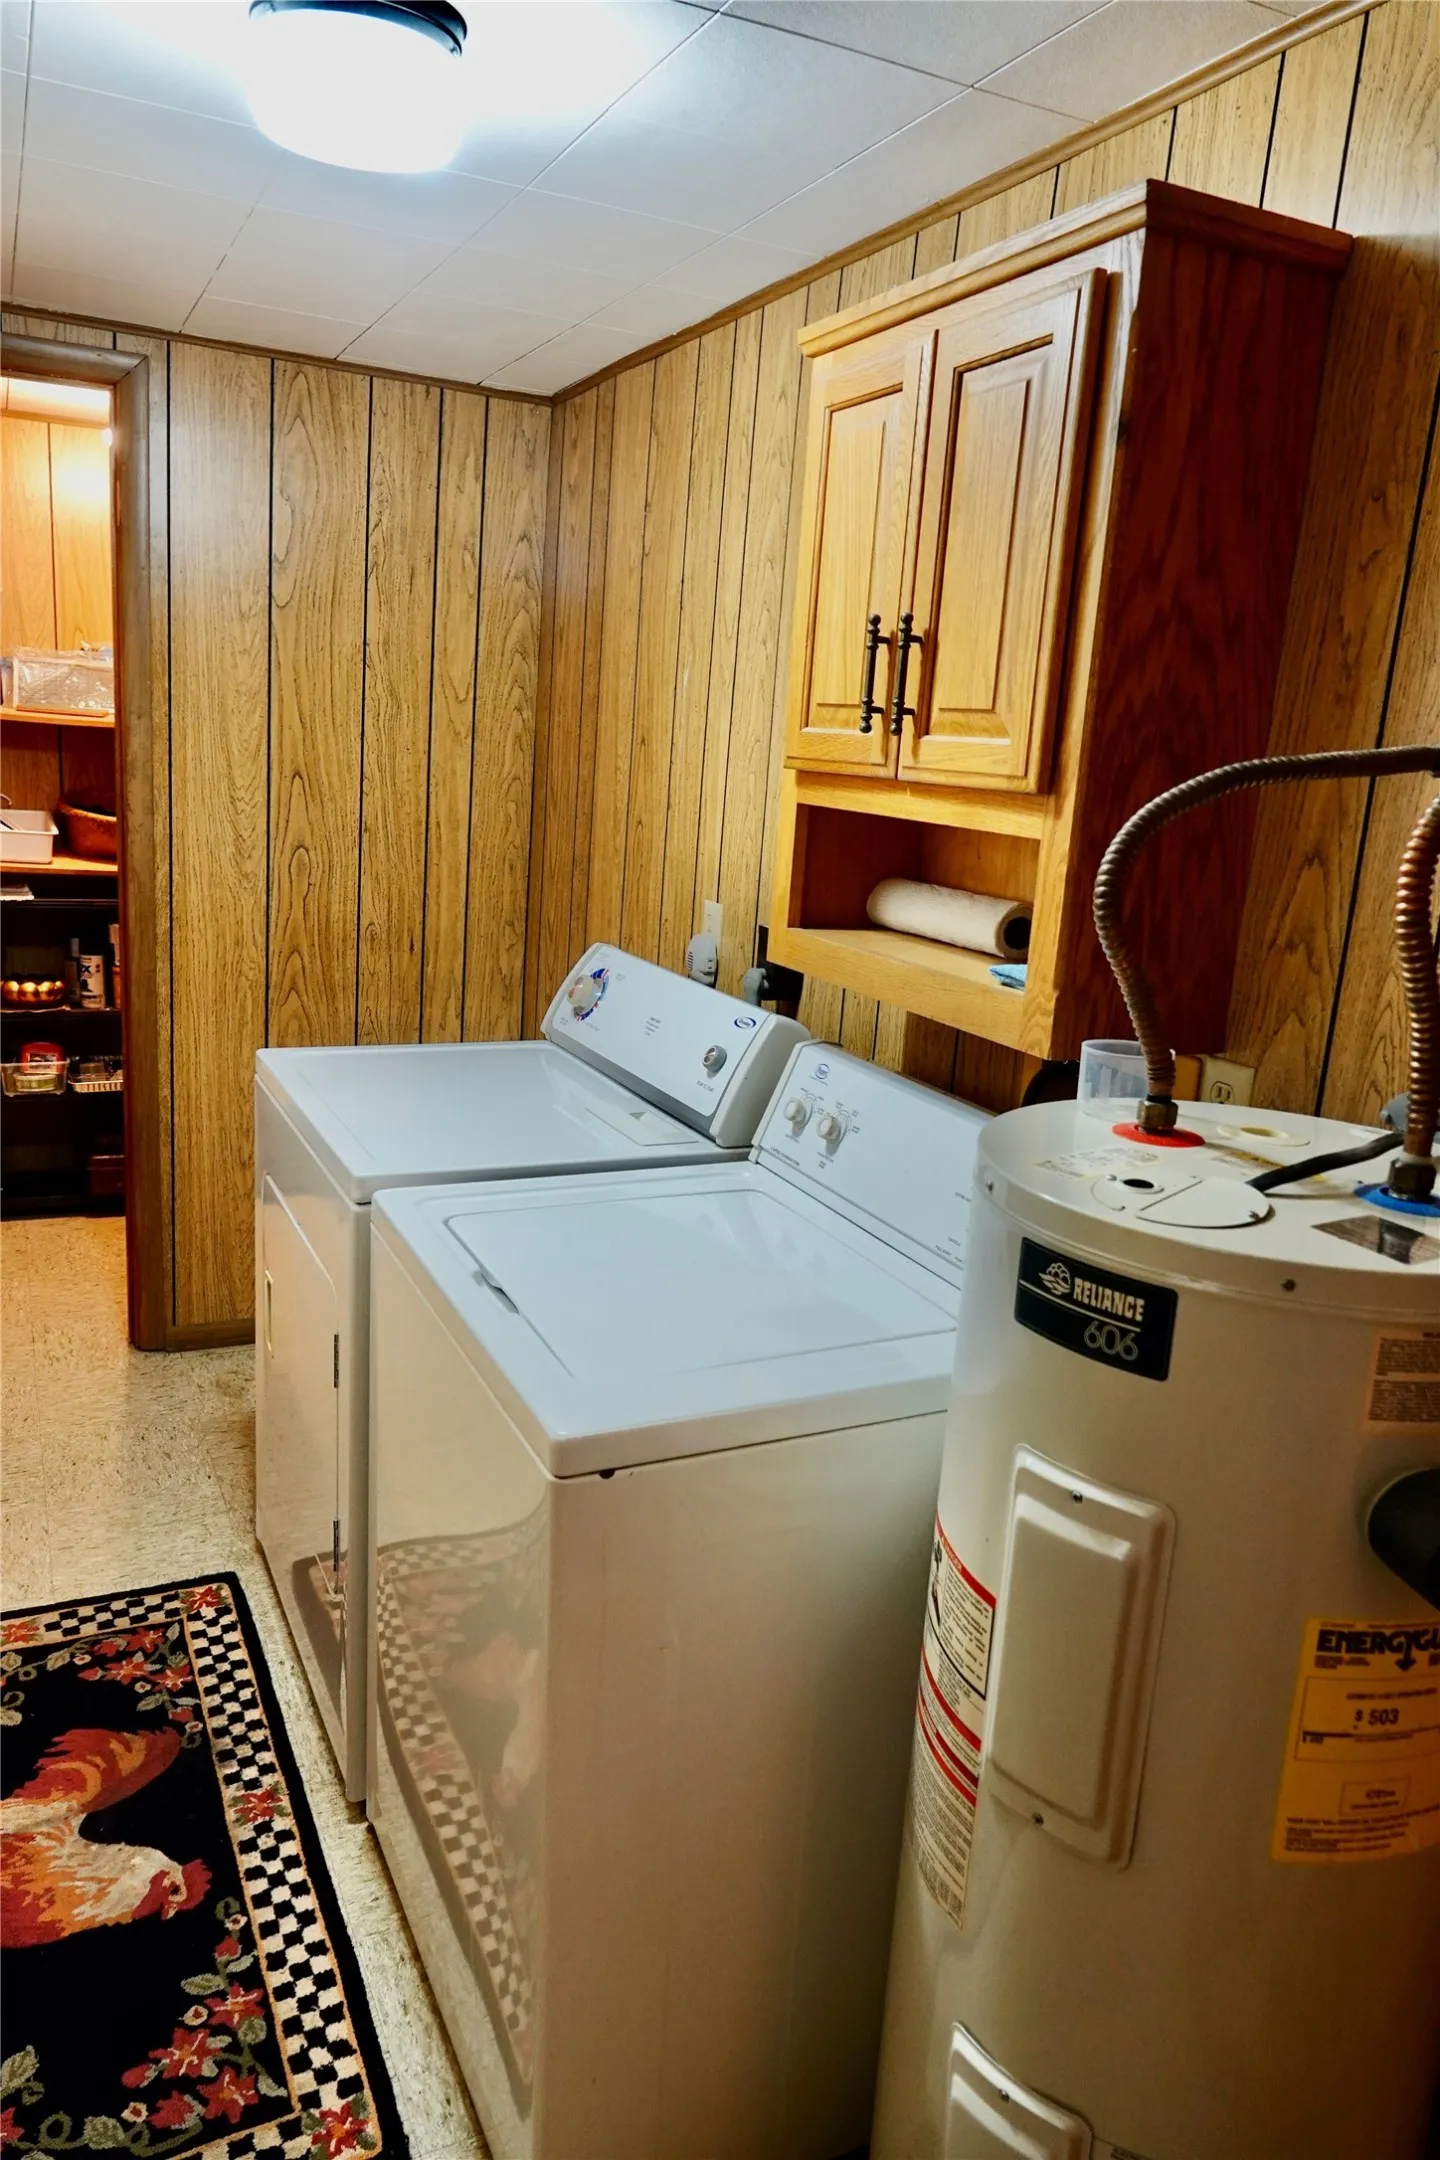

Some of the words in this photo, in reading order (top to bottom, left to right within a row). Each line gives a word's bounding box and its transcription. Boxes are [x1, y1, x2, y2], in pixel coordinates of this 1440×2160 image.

[1073, 1277, 1146, 1322] RELIANCE
[1083, 1320, 1139, 1361] 606
[1368, 1707, 1399, 1726] 503
